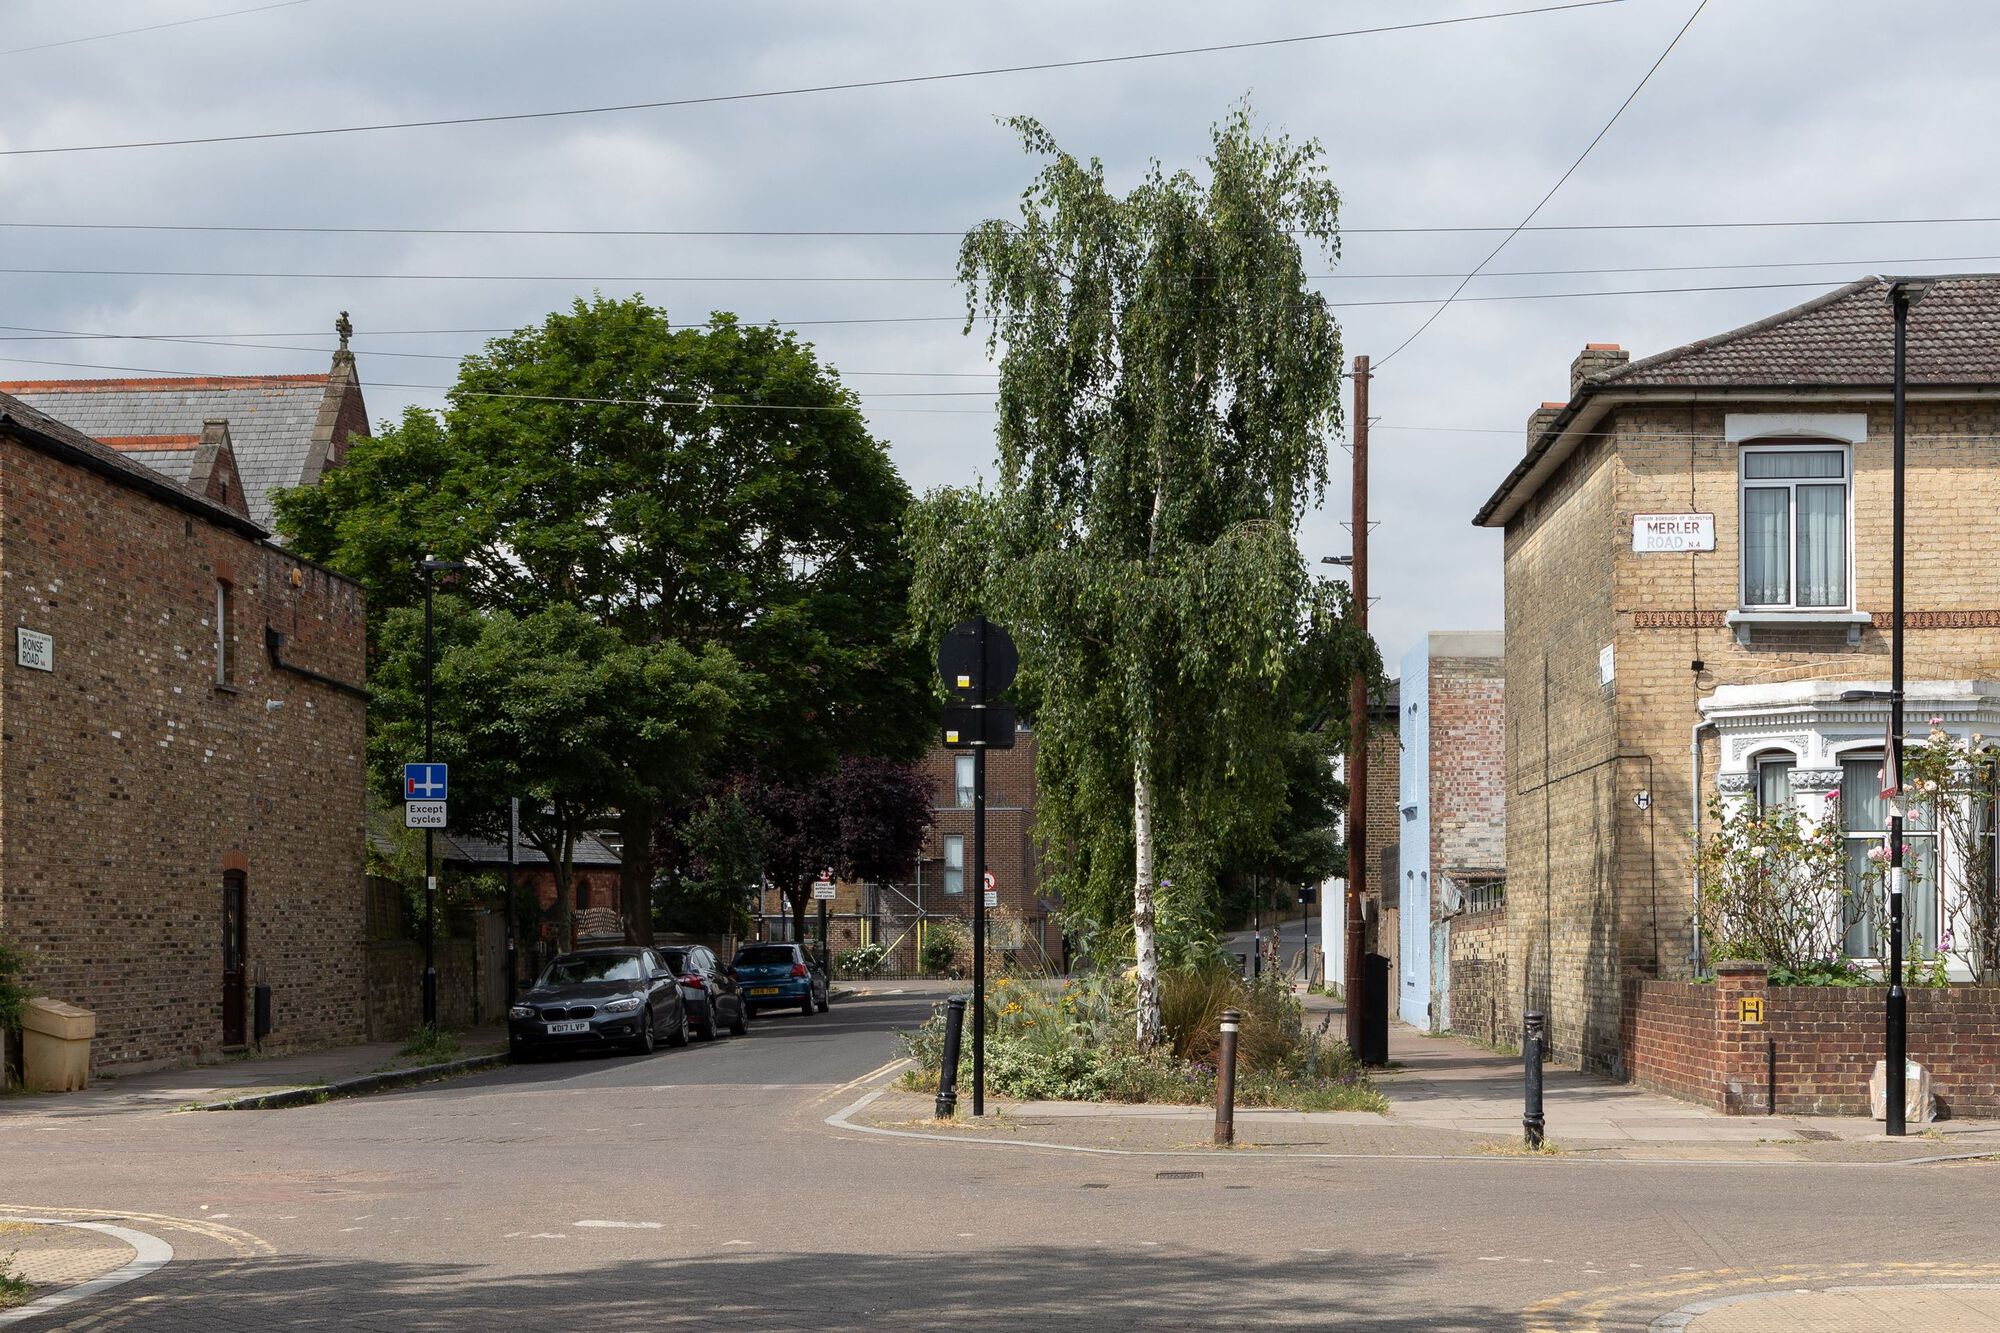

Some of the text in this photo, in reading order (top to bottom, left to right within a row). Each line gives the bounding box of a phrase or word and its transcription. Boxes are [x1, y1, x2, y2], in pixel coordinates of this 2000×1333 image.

[1647, 522, 1700, 534] MERLER
[1647, 536, 1683, 549] ROAD
[22, 637, 43, 653] RONSE
[22, 651, 39, 665] ROAD
[410, 804, 443, 815] Except
[411, 815, 441, 824] cycles
[1742, 1001, 1759, 1021] H
[570, 1023, 585, 1031] LVP
